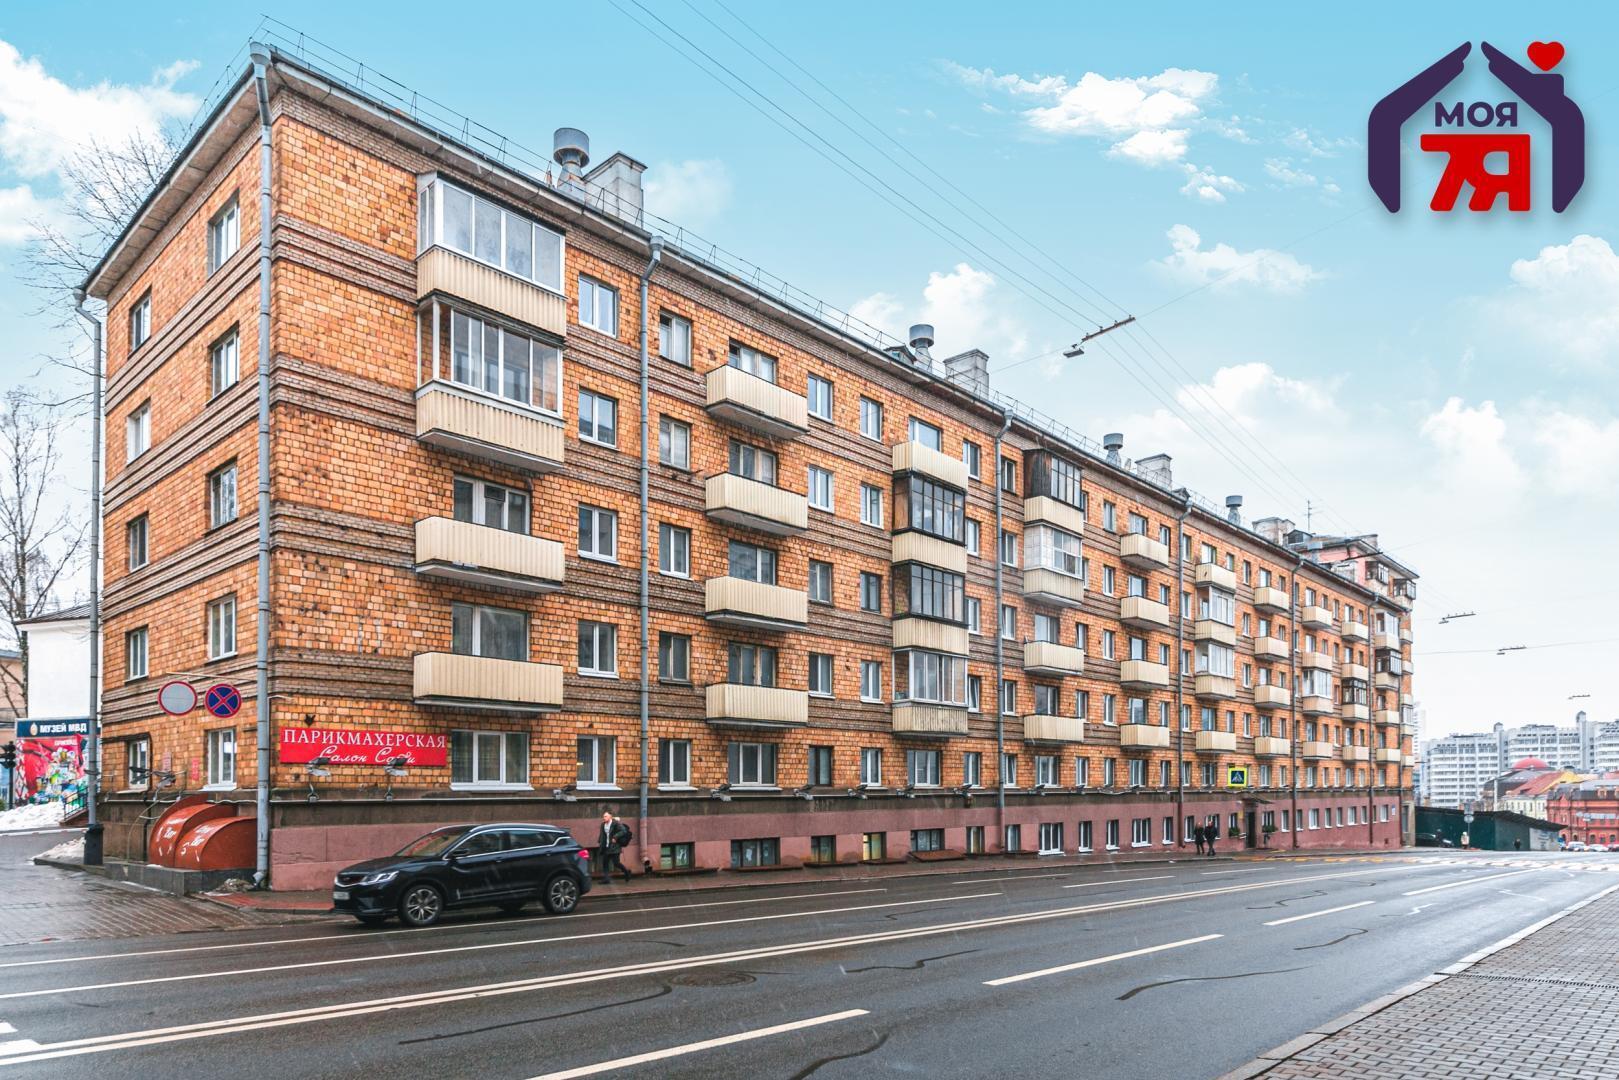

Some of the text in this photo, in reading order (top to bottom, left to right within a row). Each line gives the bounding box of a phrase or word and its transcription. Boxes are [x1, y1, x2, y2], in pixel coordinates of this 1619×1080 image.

[40, 722, 87, 733] МУЗЕЙ МВД
[283, 729, 446, 748] ПАРИКМАХЕРСКАЯ
